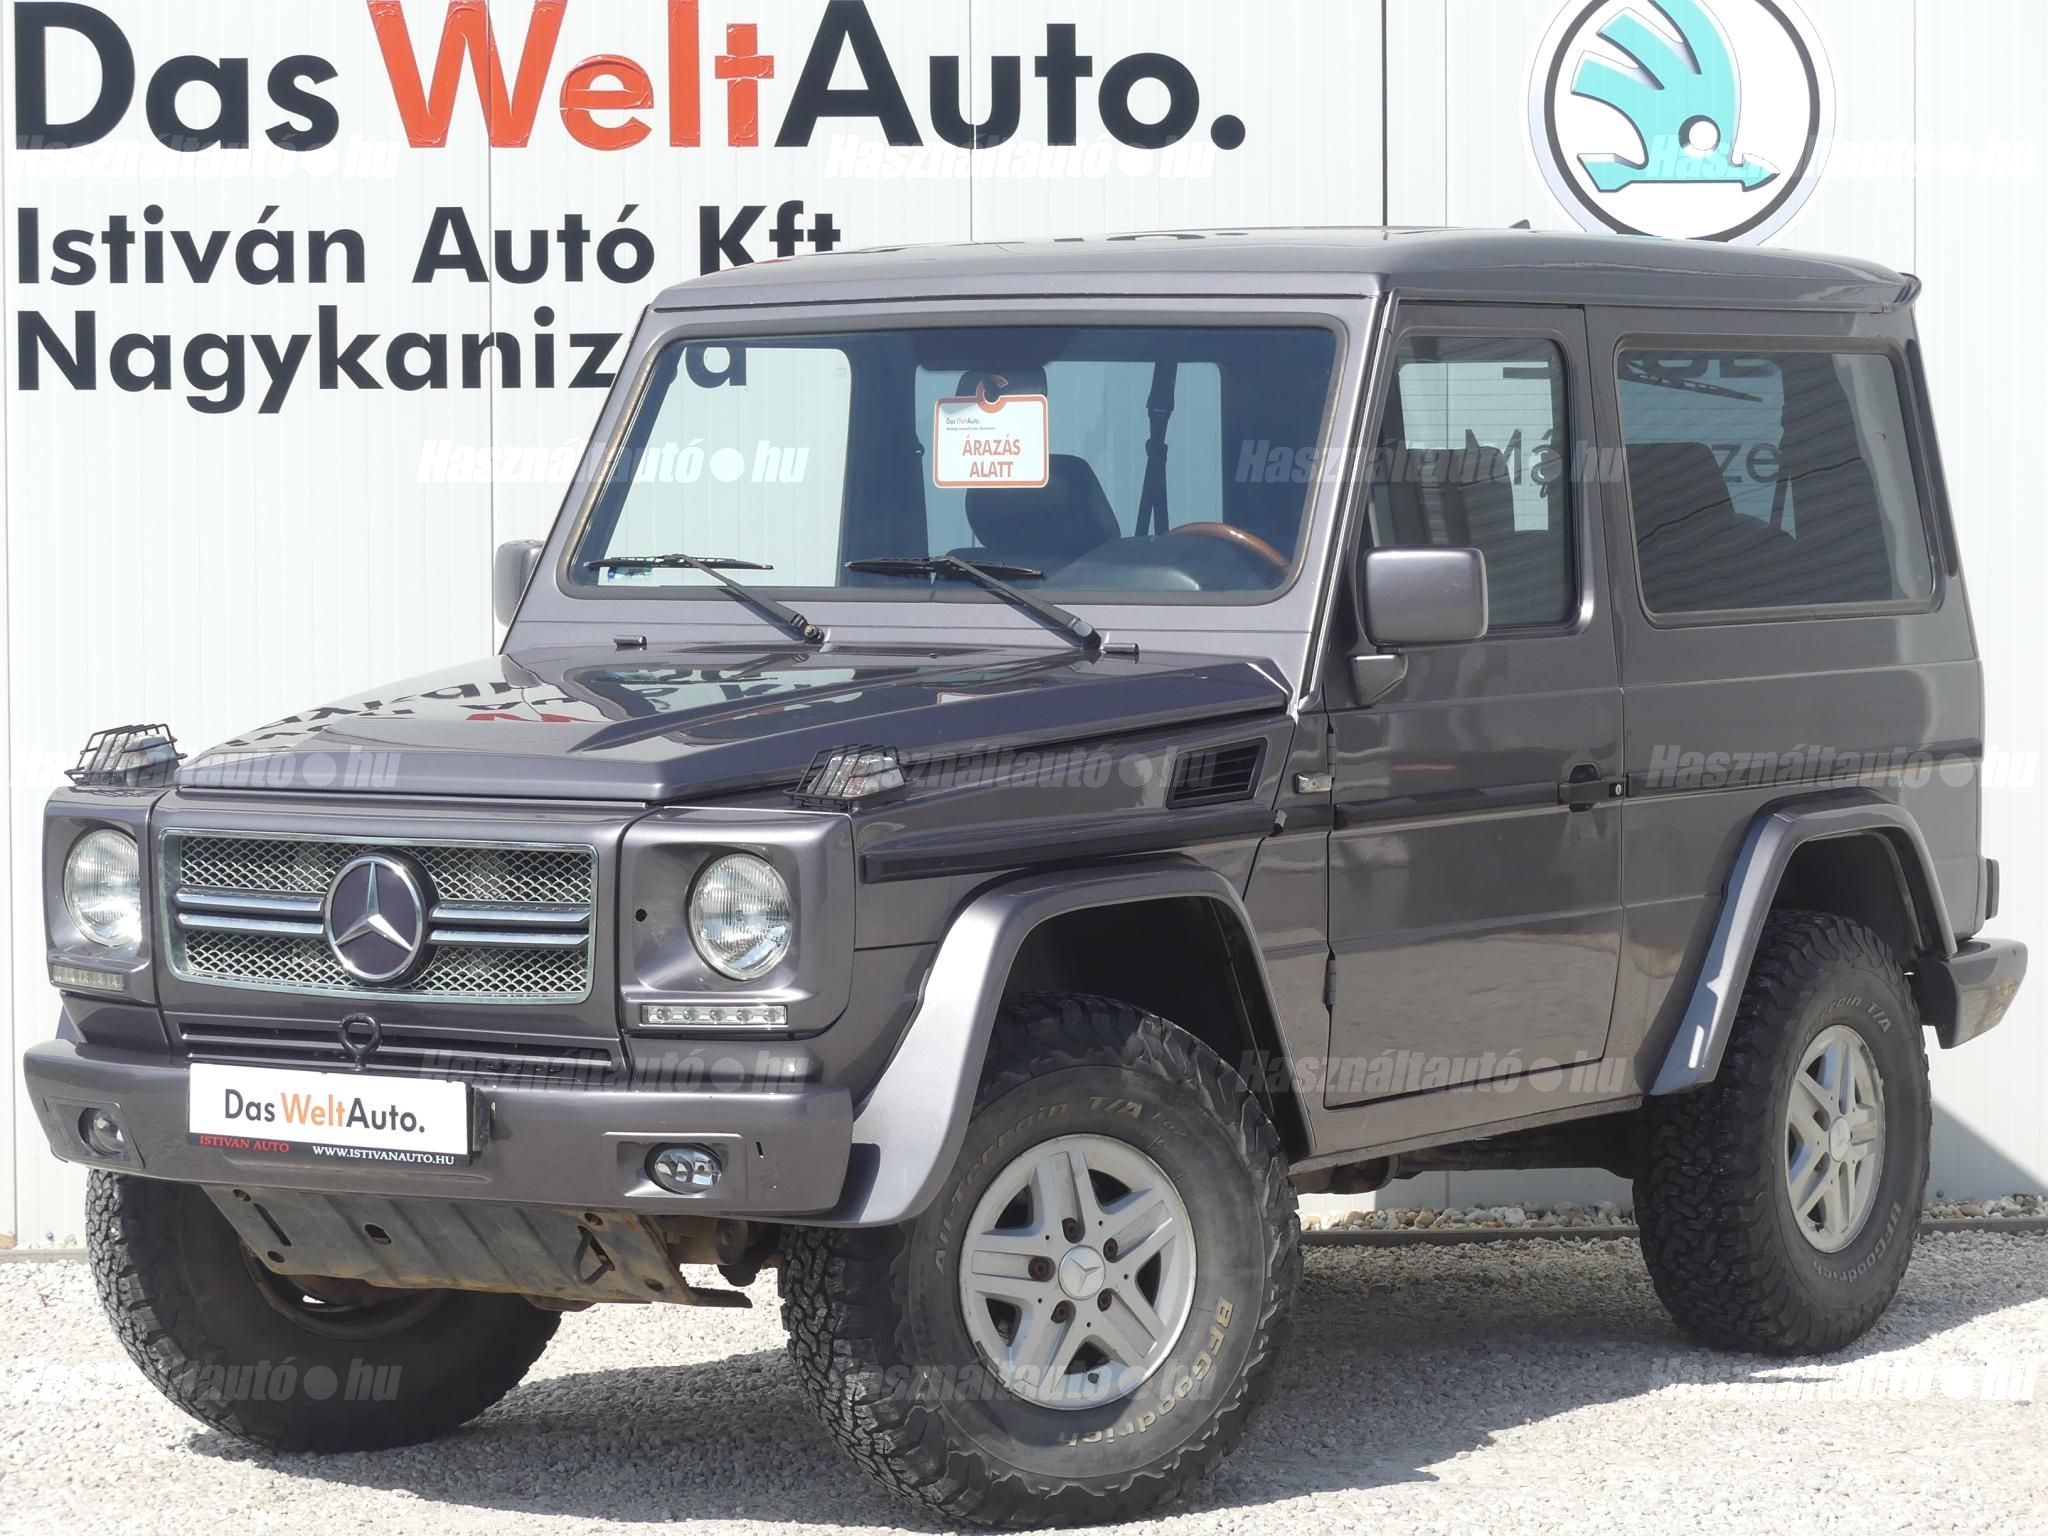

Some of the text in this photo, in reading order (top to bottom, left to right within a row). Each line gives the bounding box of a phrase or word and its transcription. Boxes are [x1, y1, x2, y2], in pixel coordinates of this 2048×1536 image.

[13, 0, 1247, 152] Das WeltAuto.
[17, 200, 841, 286] Istiván Autó Kft
[17, 305, 747, 414] Nagykaniza
[962, 433, 1022, 456] ÁRAZÁS
[969, 461, 1014, 478] ALATT
[225, 1088, 425, 1134] Das WeltAuto.
[1088, 1095, 1143, 1121] T/A
[200, 1135, 455, 1166] ISTIVAN AUTO WWW.ISTIVANAUTO.HU
[1057, 1296, 1235, 1448] BFGoodrich
